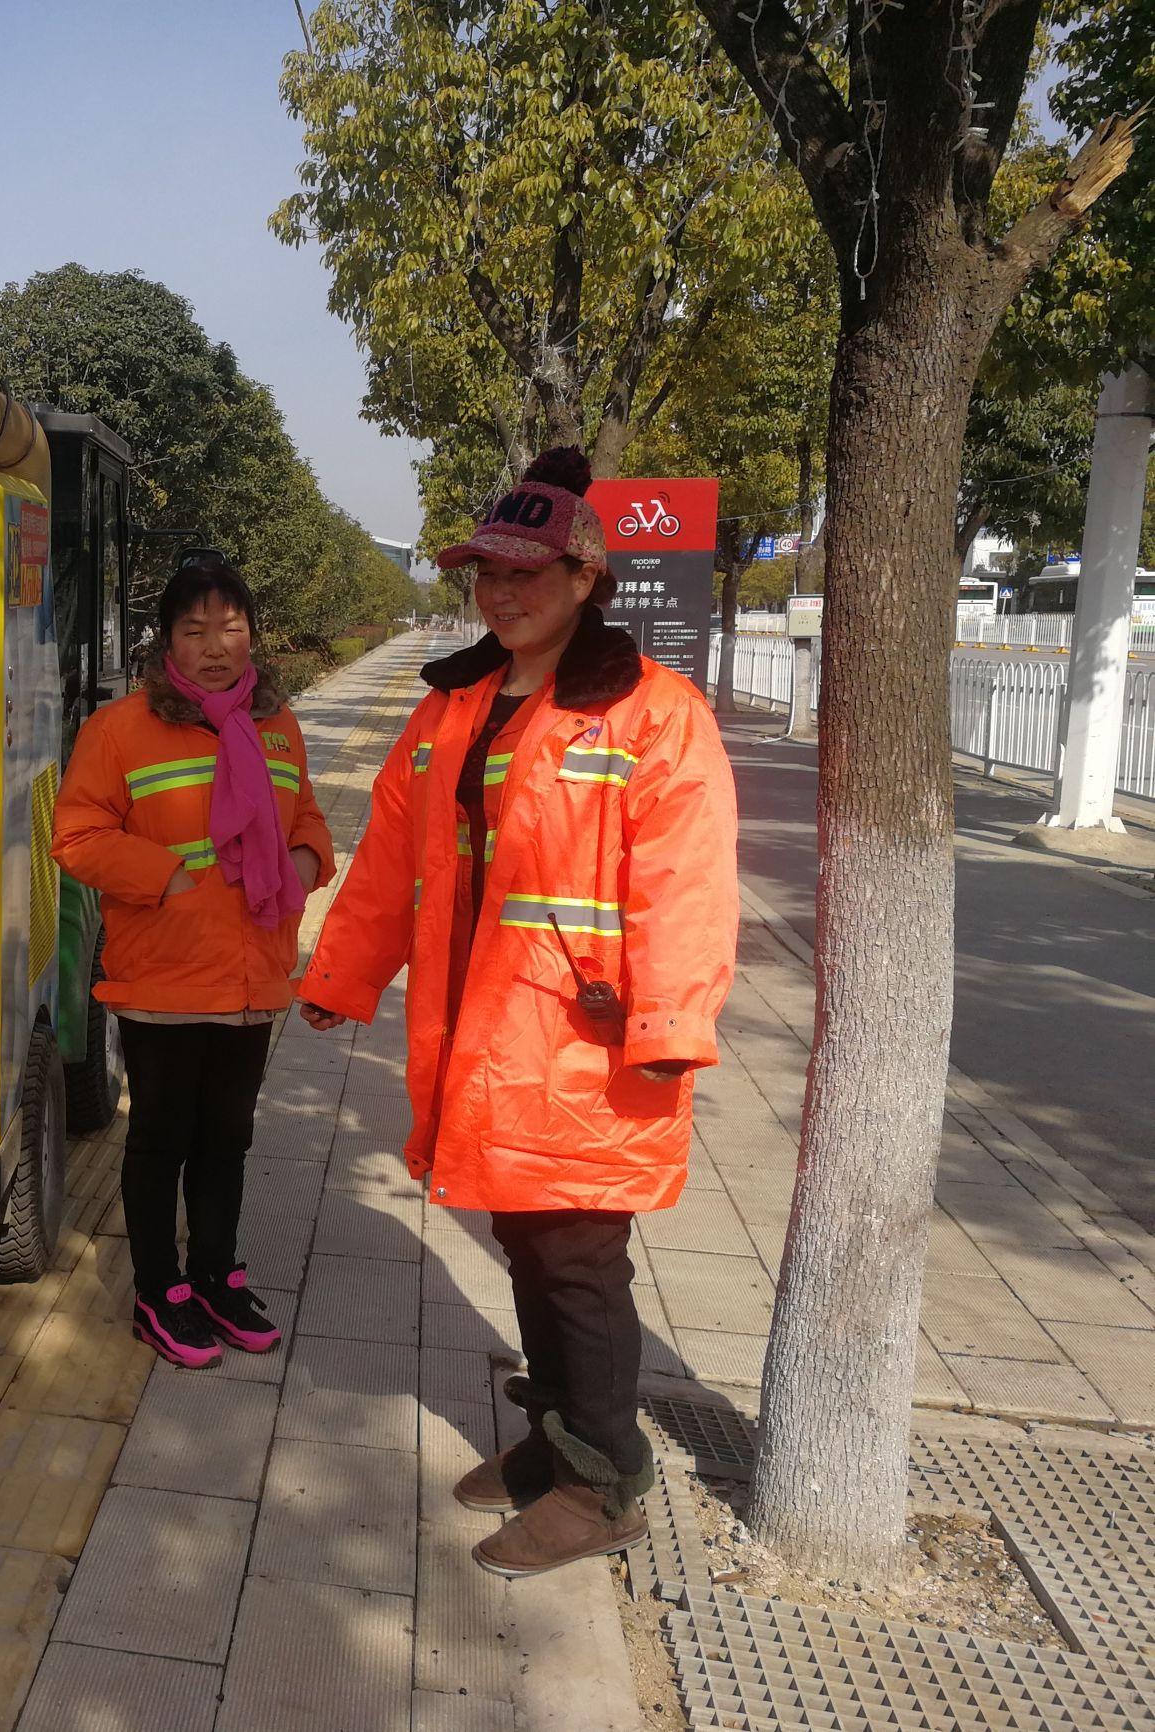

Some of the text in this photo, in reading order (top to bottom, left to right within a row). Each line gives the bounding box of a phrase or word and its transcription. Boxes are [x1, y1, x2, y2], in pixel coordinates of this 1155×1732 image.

[609, 596, 679, 609] 推荐停车点
